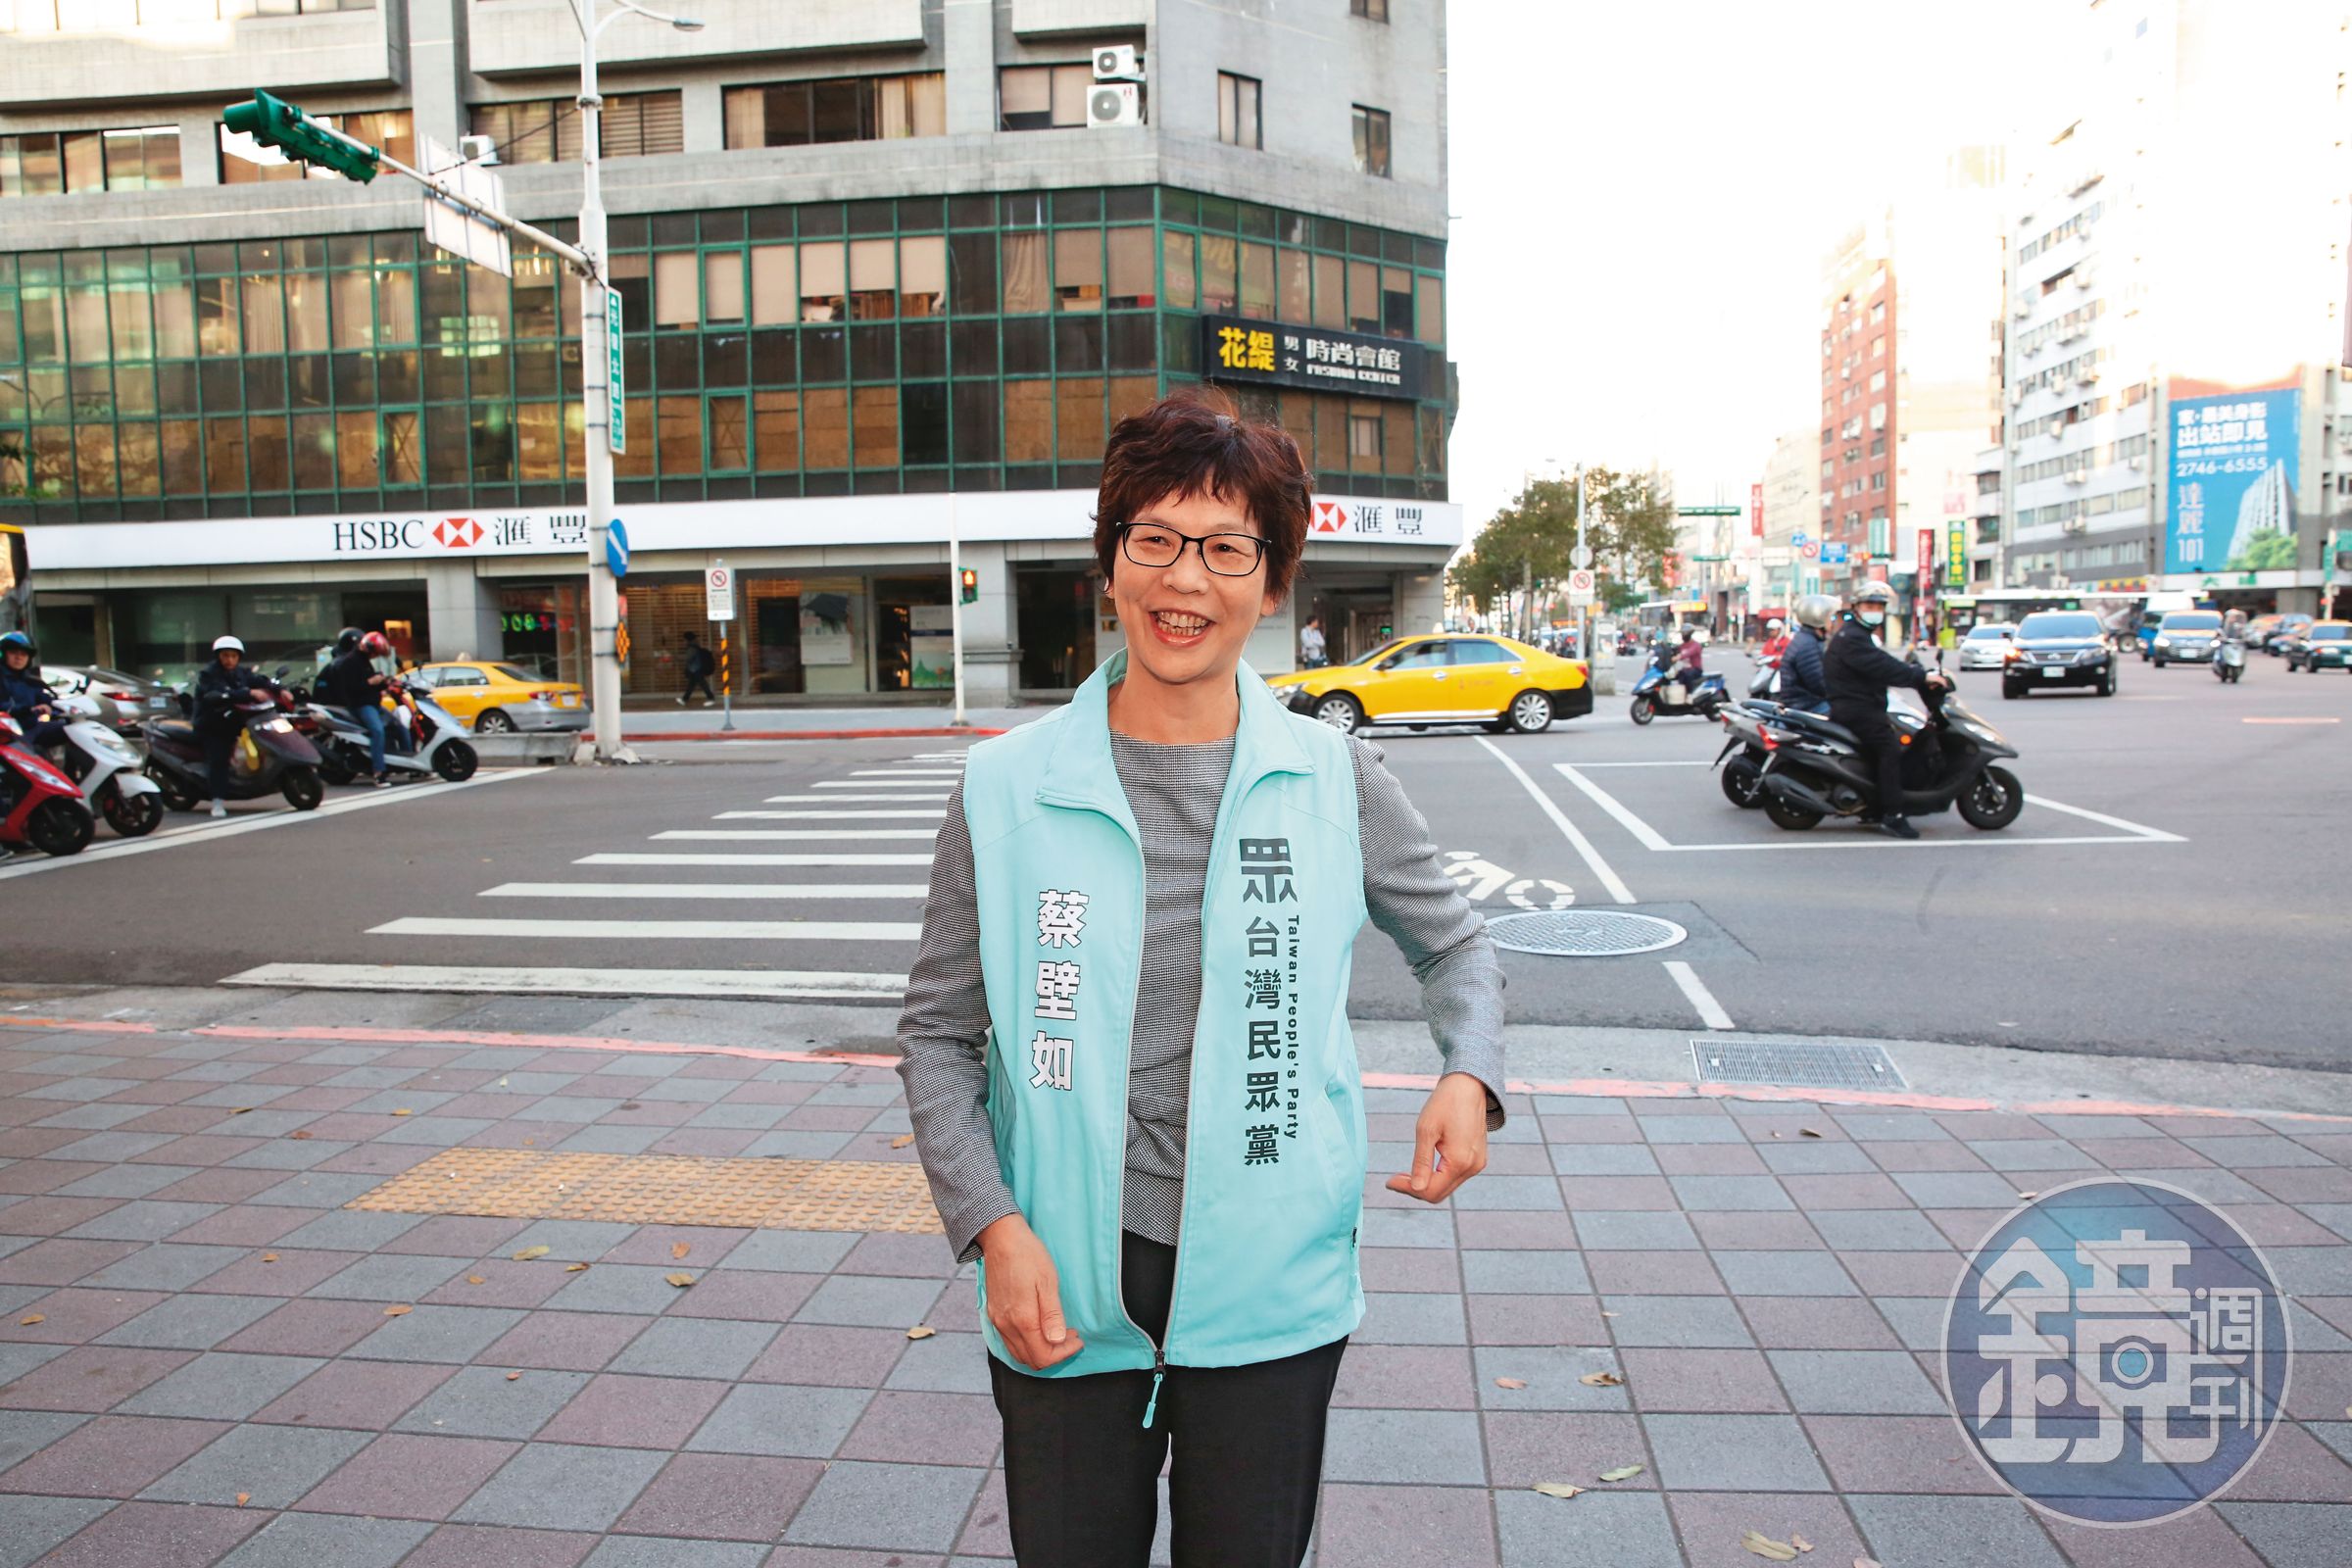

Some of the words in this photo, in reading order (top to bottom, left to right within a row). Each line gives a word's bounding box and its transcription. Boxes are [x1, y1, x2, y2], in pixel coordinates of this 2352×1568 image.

[1217, 325, 1276, 371] 花緹
[1305, 337, 1401, 371] 時尚會館
[2176, 456, 2269, 477] 2746-6555
[333, 518, 424, 551] HSBC
[1287, 914, 1299, 984] Taiwan
[1029, 889, 1090, 1092] 蔡壁如
[1244, 915, 1283, 1166] 台灣民眾黨
[1285, 993, 1299, 1079] People's
[1284, 1088, 1299, 1140] Party
